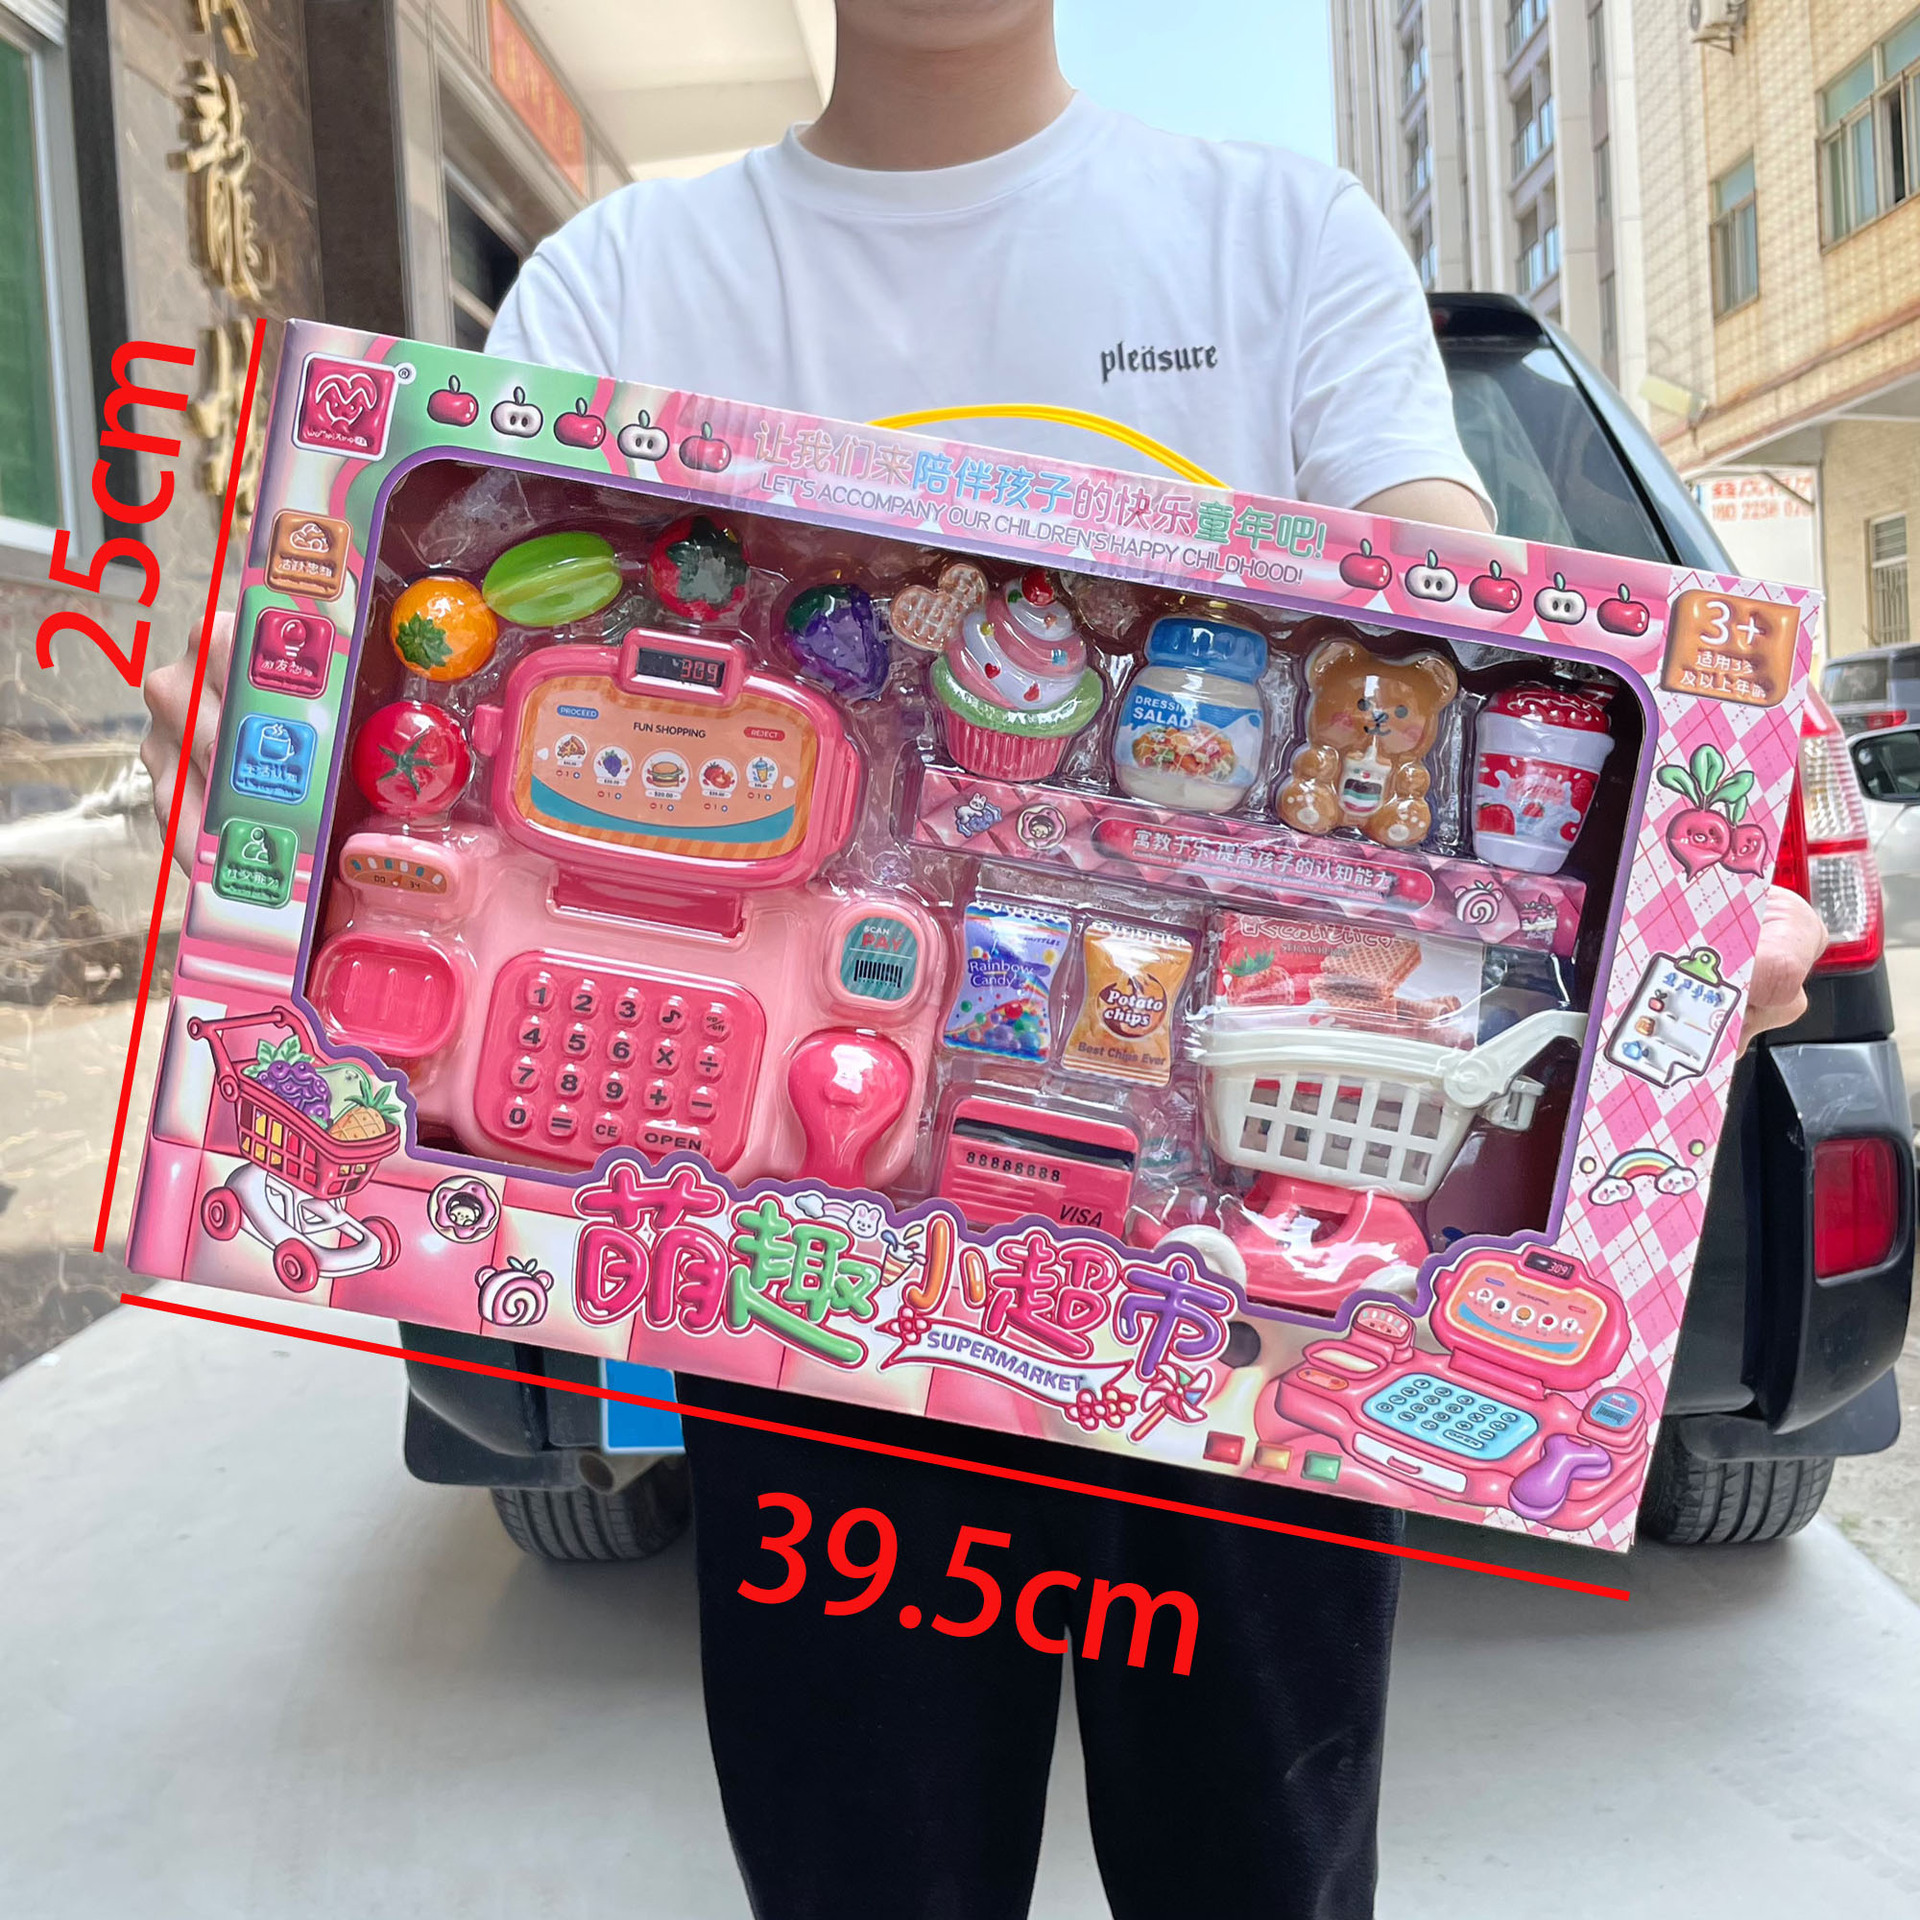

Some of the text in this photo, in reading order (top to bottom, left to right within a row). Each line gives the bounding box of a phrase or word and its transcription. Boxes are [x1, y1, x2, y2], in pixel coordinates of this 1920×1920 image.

[761, 472, 816, 498] LET'S
[817, 484, 946, 521] ACCOMPANY
[948, 506, 992, 530] OUR
[1111, 536, 1182, 564] HAPPY
[1182, 550, 1303, 585] CHILDHOOD!
[1700, 601, 1760, 645] 3+
[560, 706, 598, 719] PROCEED
[1133, 707, 1192, 728] SALAD
[634, 722, 706, 739] FUN SHOPPING
[750, 728, 779, 739] REJECT
[863, 925, 890, 935] SCAN
[862, 933, 904, 952] PAY
[969, 960, 1034, 977] Rainbow
[972, 973, 1014, 988] Candy
[534, 987, 547, 1005] 1
[576, 993, 593, 1012] 2
[1108, 989, 1164, 1012] Potato
[619, 1001, 636, 1019] 3
[1104, 1008, 1150, 1027] chips
[522, 1027, 541, 1045] 4
[568, 1034, 586, 1051] 5
[613, 1042, 630, 1060] 6
[1077, 1041, 1167, 1066] Best Chips Ever
[517, 1067, 535, 1085] 7
[560, 1074, 578, 1092] 8
[606, 1081, 624, 1099] 9
[509, 1107, 526, 1125] 0
[595, 1124, 618, 1138] CE
[644, 1132, 702, 1150] OPEN
[1059, 1204, 1103, 1228] VISA
[927, 1330, 1084, 1391] SUPERMARKET
